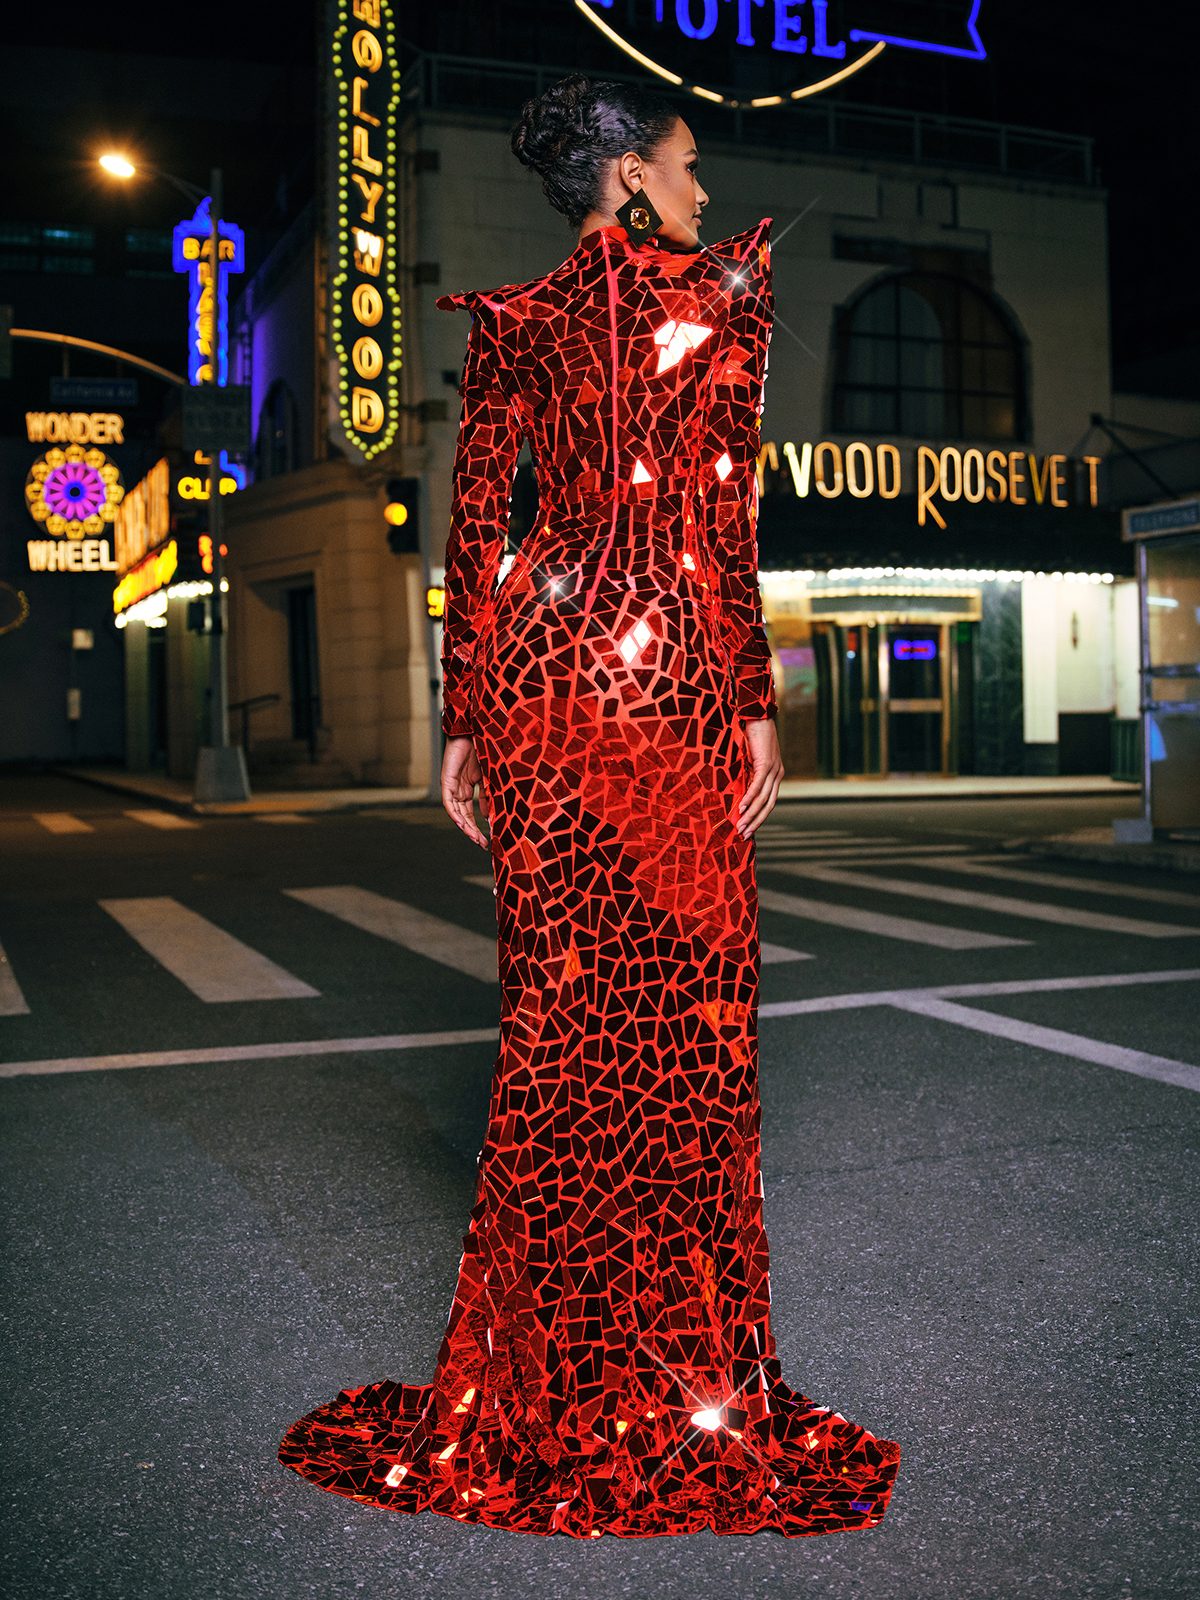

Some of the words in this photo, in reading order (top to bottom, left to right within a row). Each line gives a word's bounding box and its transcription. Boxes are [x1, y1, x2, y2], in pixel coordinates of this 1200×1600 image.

[183, 238, 236, 262] BAR
[25, 411, 125, 444] WONDER
[918, 445, 1101, 530] ROOSEVET
[27, 540, 120, 572] WHEEL
